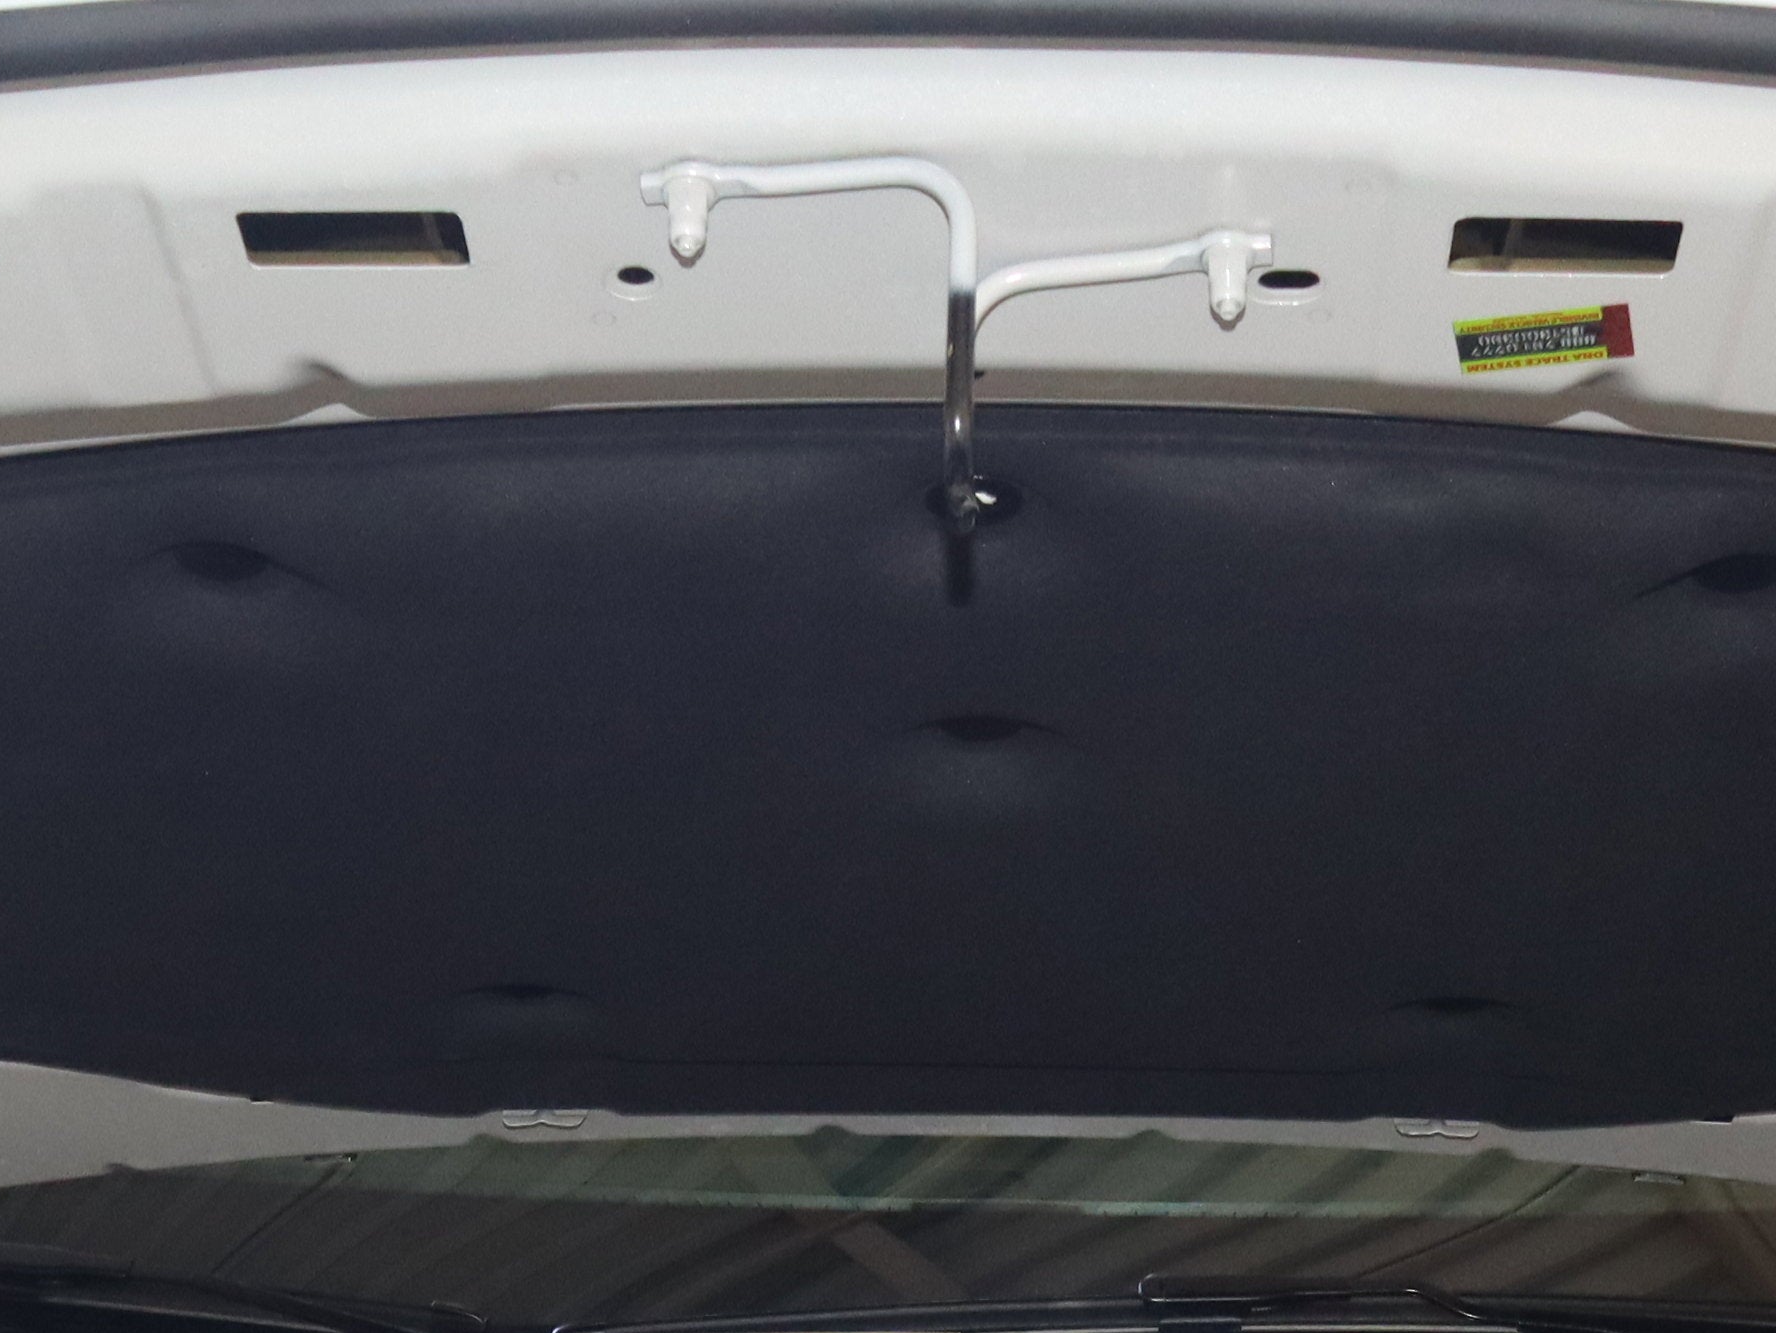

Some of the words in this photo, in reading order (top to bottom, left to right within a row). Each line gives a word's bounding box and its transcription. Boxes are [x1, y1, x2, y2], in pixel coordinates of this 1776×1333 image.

[1525, 355, 1569, 365] TRACE
[1572, 351, 1604, 360] DNA
[1467, 361, 1521, 372] SYSTEM
